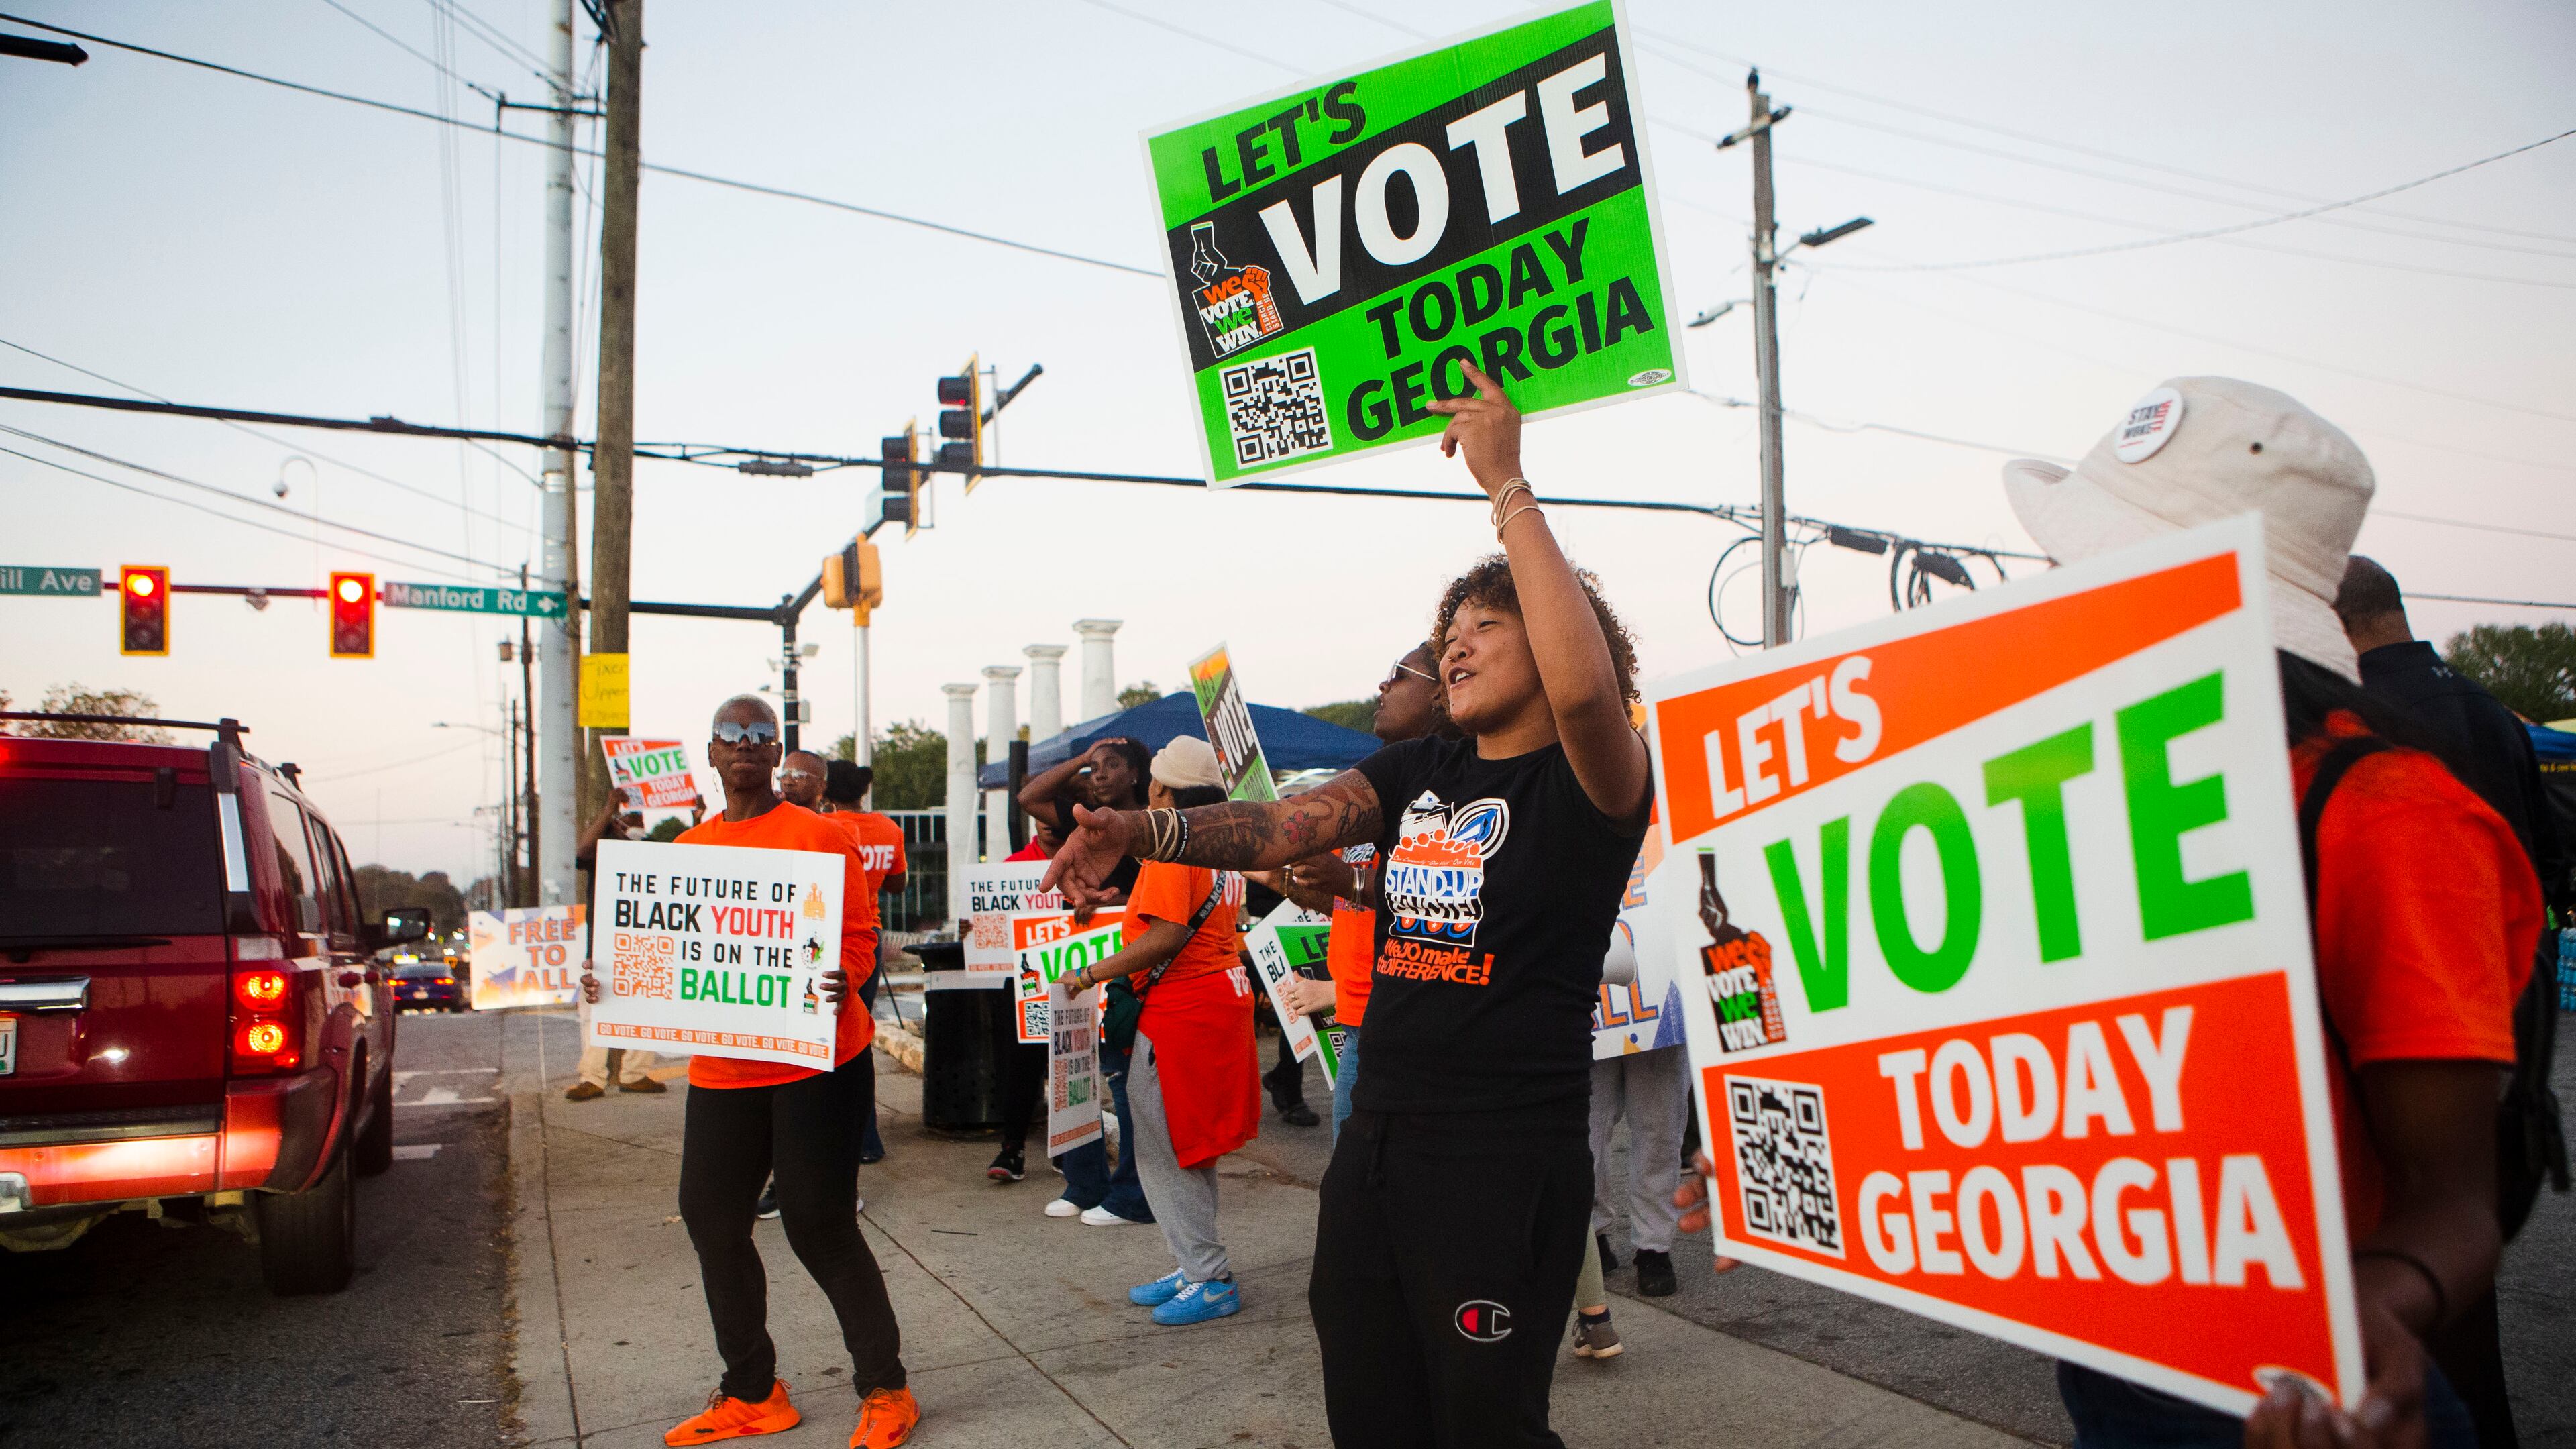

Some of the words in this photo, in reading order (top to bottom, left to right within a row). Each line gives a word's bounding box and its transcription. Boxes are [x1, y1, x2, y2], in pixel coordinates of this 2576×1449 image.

[1201, 81, 1367, 203] LET'S
[1258, 52, 1626, 306] VOTE
[1203, 276, 1242, 305] we
[1366, 217, 1591, 360] TODAY
[1214, 307, 1253, 335] we
[1256, 300, 1273, 331] GEORGIA
[1262, 293, 1281, 329] STAND-UP
[1346, 276, 1656, 441] GEORGIA
[39, 570, 92, 592] Ave
[391, 584, 485, 609] Manford
[498, 589, 527, 612] Rd
[1703, 654, 1883, 820] LET'S
[627, 749, 687, 778] VOTE
[647, 787, 696, 806] GEORGIA
[649, 775, 686, 792] TODAY
[1763, 669, 2257, 1014] VOTE
[616, 873, 657, 894] THE
[671, 876, 758, 901] FUTURE
[771, 882, 797, 903] OF
[971, 881, 994, 893] THE
[1385, 866, 1483, 898] STAND-UP
[973, 894, 1020, 912] BLACK
[1024, 892, 1063, 910] YOUT
[508, 919, 576, 945] FREE
[615, 899, 702, 933] BLACK
[710, 906, 794, 939] YOUTH
[1026, 916, 1071, 947] LET'S
[526, 944, 566, 967] TO
[682, 941, 702, 961] IS
[714, 943, 741, 964] ON
[754, 946, 793, 968] THE
[1259, 941, 1277, 961] THE
[1384, 939, 1400, 957] We
[1420, 947, 1470, 965] make
[1707, 939, 1746, 973] we
[521, 967, 576, 991] ALL
[680, 968, 792, 1008] BALLOT
[1591, 981, 1660, 1031] LL
[1719, 991, 1758, 1024] we
[600, 1024, 612, 1035] GO
[641, 1027, 653, 1038] GO
[681, 1030, 693, 1042] GO
[722, 1033, 733, 1045] GO
[762, 1036, 774, 1049] GO
[798, 1042, 808, 1054] GO
[1879, 1005, 2196, 1152] TODAY
[1857, 1152, 2308, 1291] GEORGIA
